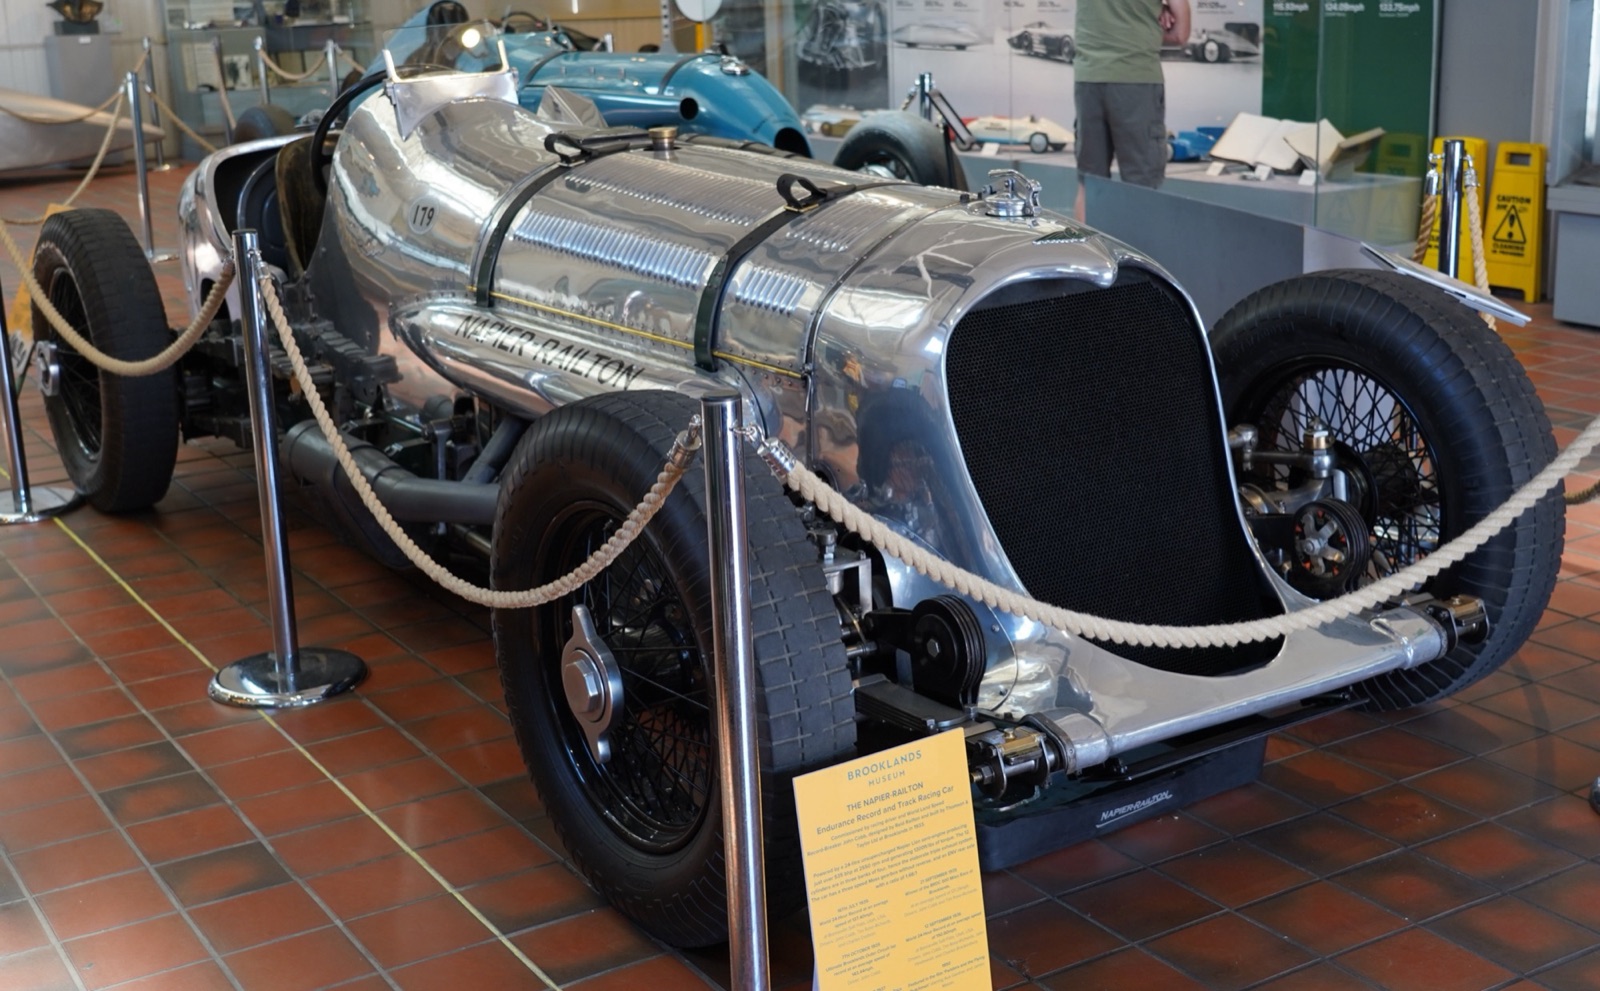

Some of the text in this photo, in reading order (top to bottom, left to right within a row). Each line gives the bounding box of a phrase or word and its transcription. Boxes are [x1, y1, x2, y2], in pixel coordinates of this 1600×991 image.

[1496, 194, 1531, 204] CAUTION
[412, 204, 434, 226] 179
[454, 314, 646, 391] NAPIER-RAILTON
[848, 750, 922, 780] BROOKLANDS
[869, 770, 905, 786] MUSEUM
[847, 782, 923, 812] THE NAPIER-RAILTON
[1100, 790, 1170, 821] NAPIER-RAILTON
[817, 785, 954, 835] Endurance Record and Track Racing Car
[831, 827, 863, 841] Commissioned
[857, 840, 870, 848] Taylor
[884, 828, 908, 839] Brooklands
[814, 868, 833, 878] Powered
